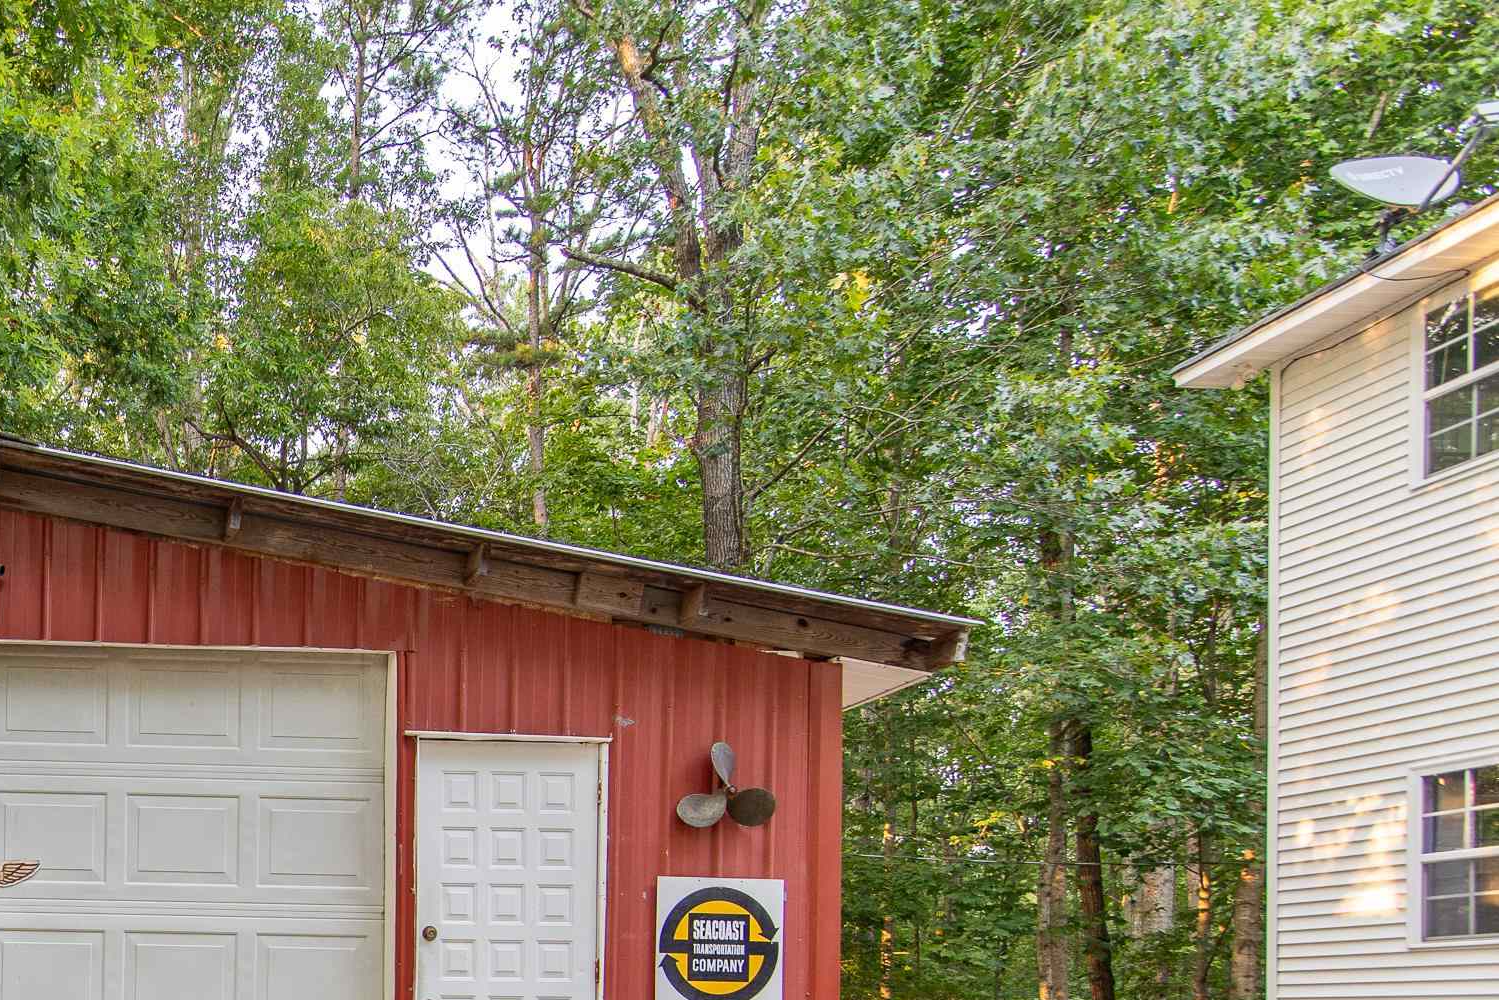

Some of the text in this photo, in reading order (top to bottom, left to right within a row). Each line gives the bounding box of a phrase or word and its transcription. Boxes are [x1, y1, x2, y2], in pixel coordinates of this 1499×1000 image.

[692, 919, 746, 941] SEACOAST
[693, 943, 746, 956] TRANSPORTATION
[692, 958, 745, 973] COMPANY
